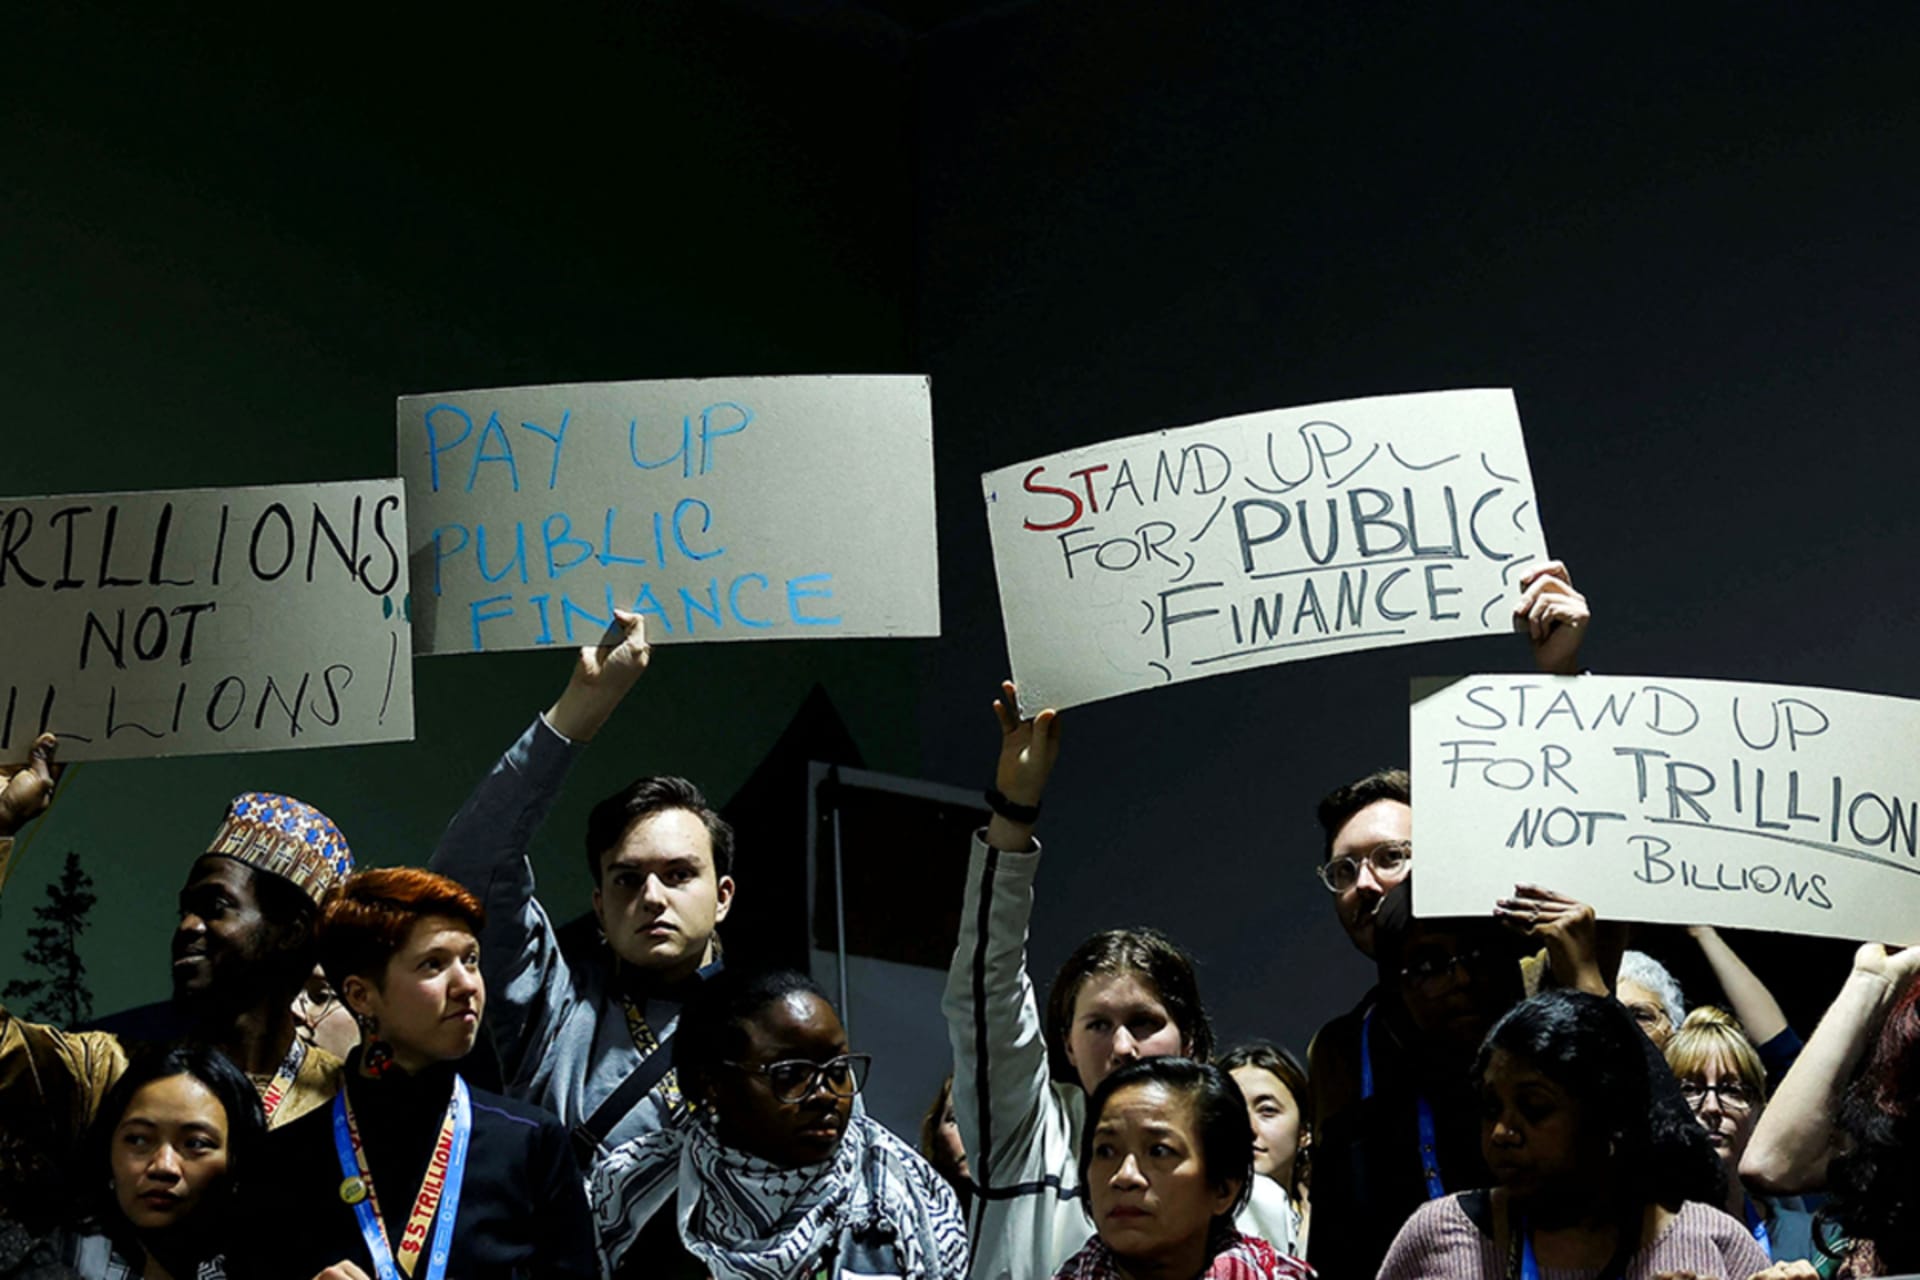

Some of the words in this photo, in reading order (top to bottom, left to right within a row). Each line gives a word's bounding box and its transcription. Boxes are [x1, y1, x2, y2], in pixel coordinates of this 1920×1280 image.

[424, 403, 571, 493] PAY
[629, 401, 755, 478] UP
[1023, 443, 1232, 530] STAND
[1266, 421, 1352, 488] UP
[0, 495, 400, 595] RILLIONS
[431, 498, 726, 596] PUBLIC
[1058, 521, 1181, 578] FOR
[1232, 486, 1513, 573] PUBLIC
[79, 602, 216, 670] NOT
[469, 572, 842, 650] FINANCE
[1157, 563, 1463, 658] FINANCE
[0, 631, 398, 749] ILLIONS!
[1456, 685, 1700, 736] STAND
[1732, 697, 1830, 751] UP
[1440, 740, 1579, 794] FOR
[1613, 746, 1918, 858] TRILLION
[1505, 807, 1627, 849] NOT
[1627, 835, 1833, 910] BILLIONS
[413, 1129, 455, 1219] TRILLION!
